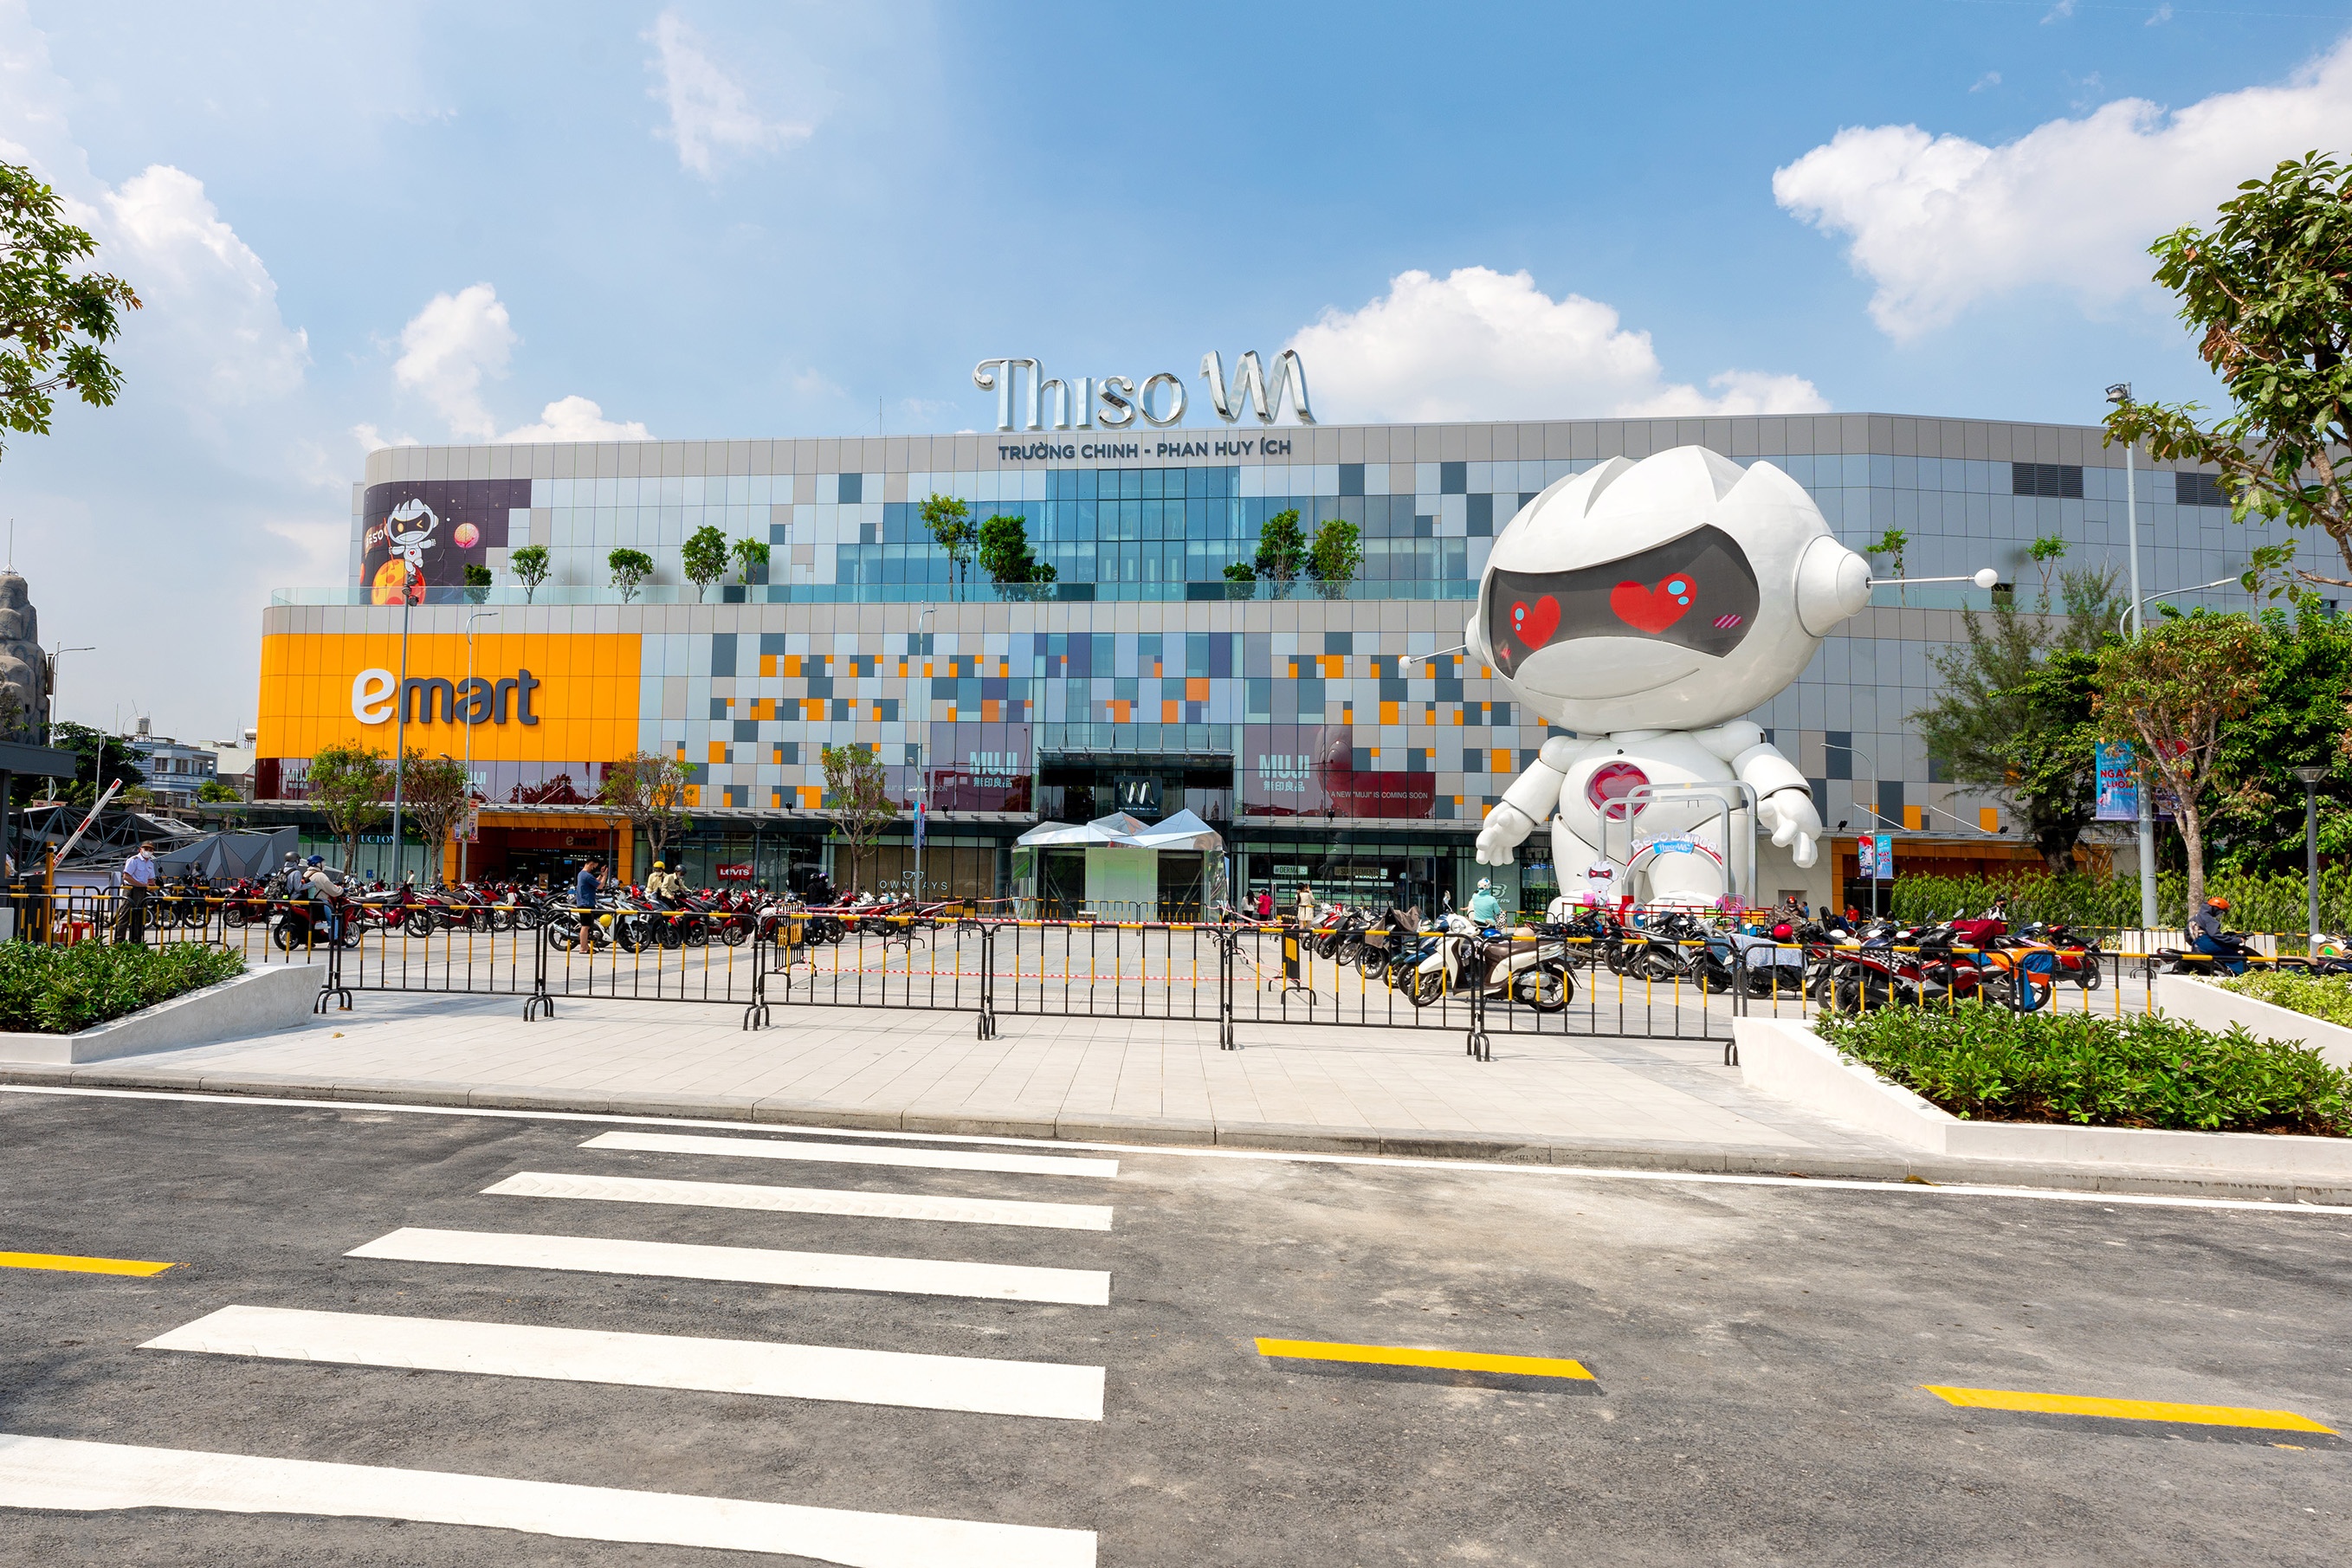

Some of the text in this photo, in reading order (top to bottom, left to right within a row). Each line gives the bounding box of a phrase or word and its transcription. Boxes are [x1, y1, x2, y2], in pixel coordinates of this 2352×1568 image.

[998, 442, 1076, 461] TRƯỜNG
[1081, 442, 1139, 459] CHINH
[1157, 441, 1209, 458] PHAN
[1215, 440, 1253, 457] HUY
[1260, 436, 1292, 455] ÍCH
[352, 668, 540, 725] emart
[969, 751, 1018, 776] MUJI
[1258, 754, 1310, 779] MUJI
[287, 768, 309, 782] MUJ
[973, 777, 1012, 789] 無印良品
[1263, 780, 1305, 792] 無印良品
[565, 836, 598, 846] emart
[1632, 831, 1669, 851] Beso
